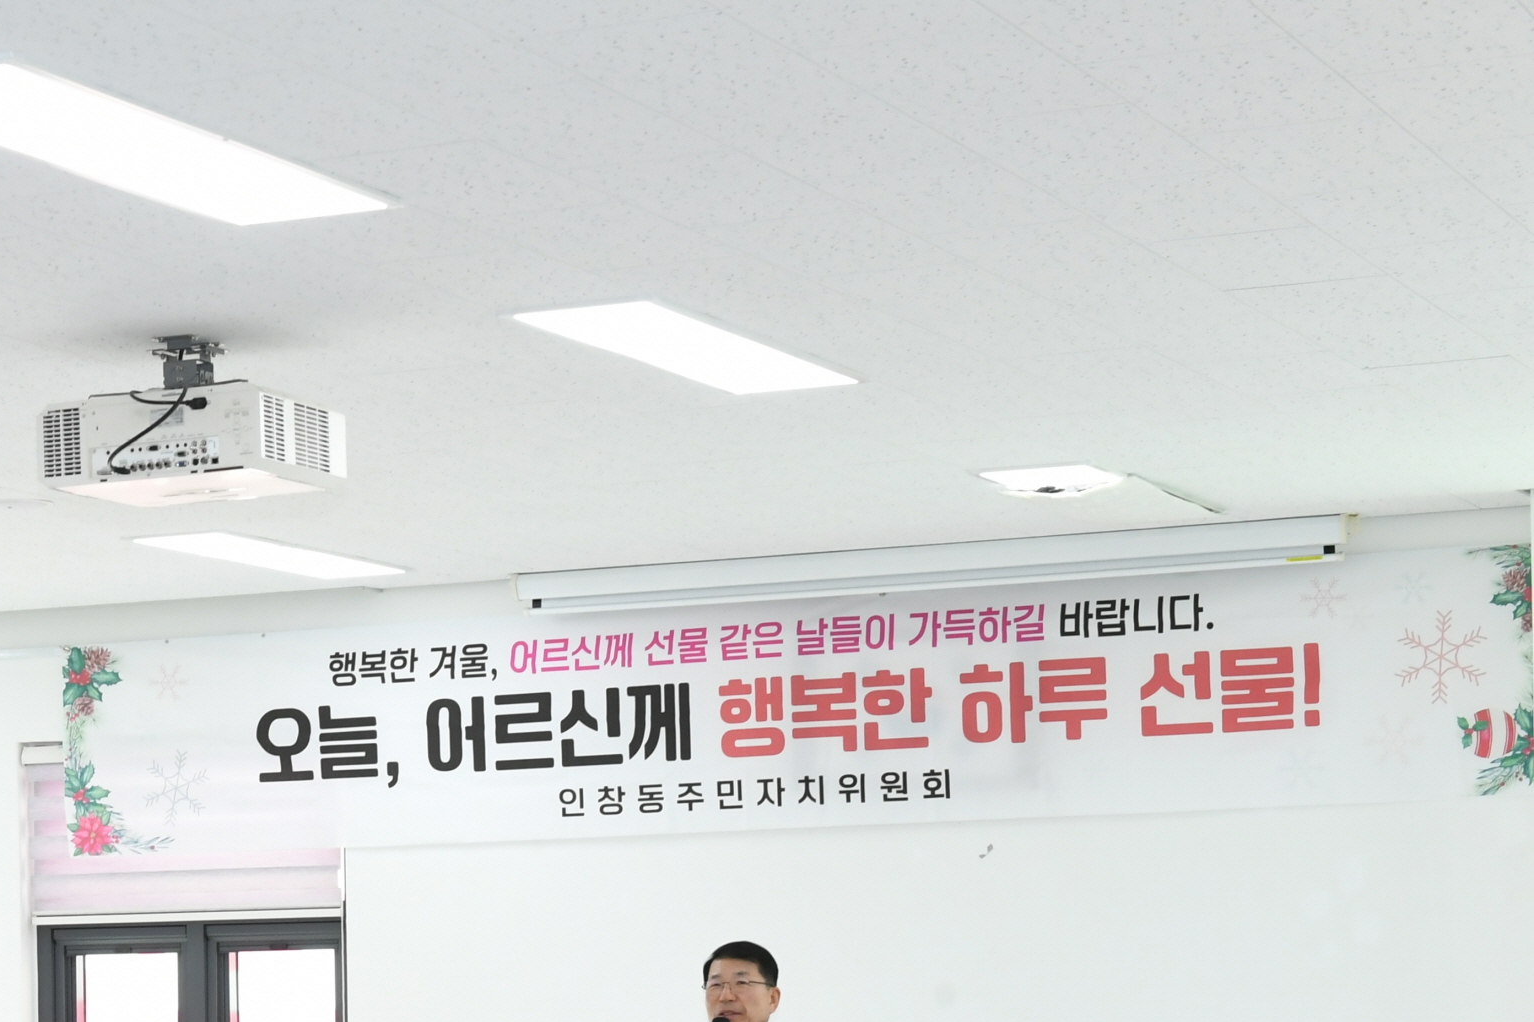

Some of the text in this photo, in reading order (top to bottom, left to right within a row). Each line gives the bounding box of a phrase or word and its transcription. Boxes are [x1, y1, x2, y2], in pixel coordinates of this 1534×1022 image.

[328, 592, 1215, 687] 행복한 겨울, 어르신께 선물 같은 날들이 가득하길 바랍니다.
[255, 642, 1321, 789] 오늘, 어르신께 행복한 하루 선물!
[558, 768, 951, 818] 인창동주민자치위원회
